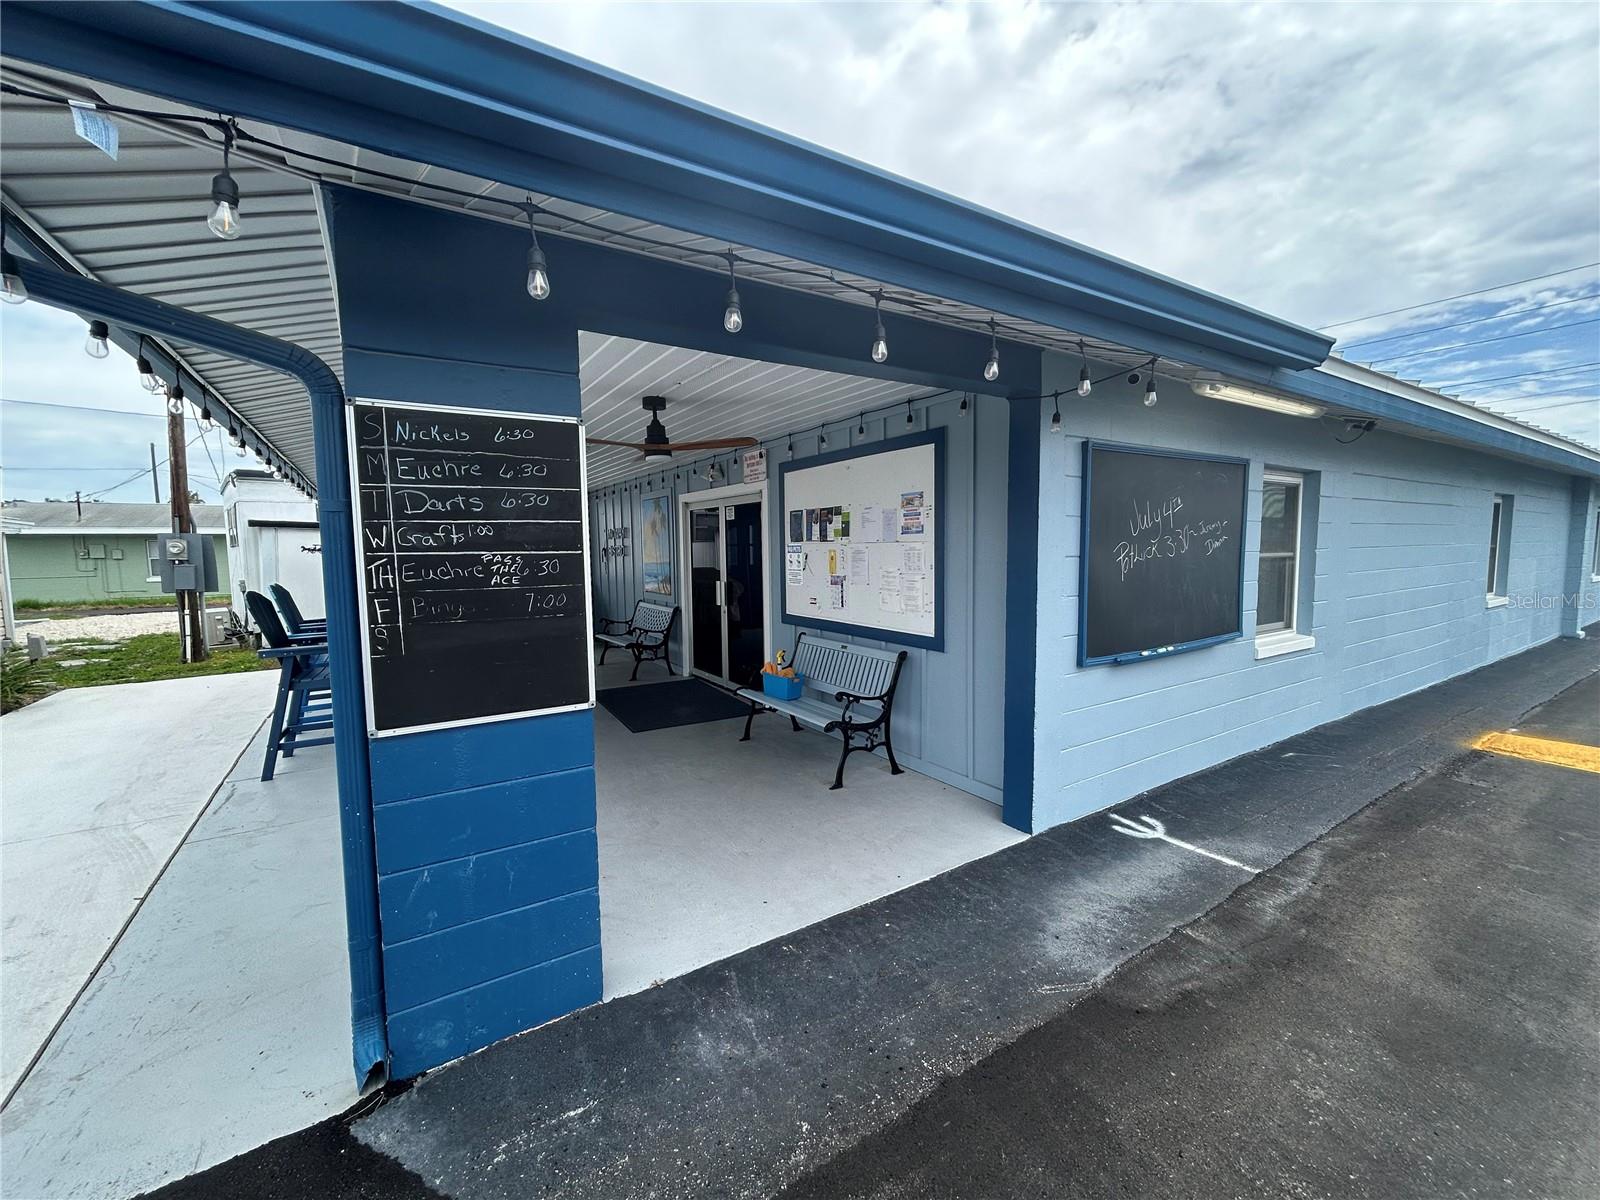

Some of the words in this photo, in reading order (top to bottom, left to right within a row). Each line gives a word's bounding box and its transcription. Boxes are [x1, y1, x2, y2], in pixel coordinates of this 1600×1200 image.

[363, 413, 382, 440] S
[395, 420, 470, 442] Nickels
[494, 427, 534, 442] 6:30
[366, 453, 386, 476] M
[396, 457, 482, 481] Euchre
[499, 463, 547, 479] 6:30
[361, 489, 385, 513] T
[394, 489, 484, 514] Darts
[500, 492, 550, 509] 6:30
[1130, 497, 1162, 543] July
[364, 525, 388, 548] W
[397, 524, 465, 547] Crafts
[468, 523, 494, 537] 1:00
[481, 553, 522, 566] PASS
[490, 564, 519, 574] THE
[366, 558, 394, 591] TH
[401, 561, 485, 582] Euchre
[517, 559, 560, 576] 6:30
[491, 575, 521, 586] ACE
[373, 598, 390, 624] F
[525, 593, 567, 613] 7:00
